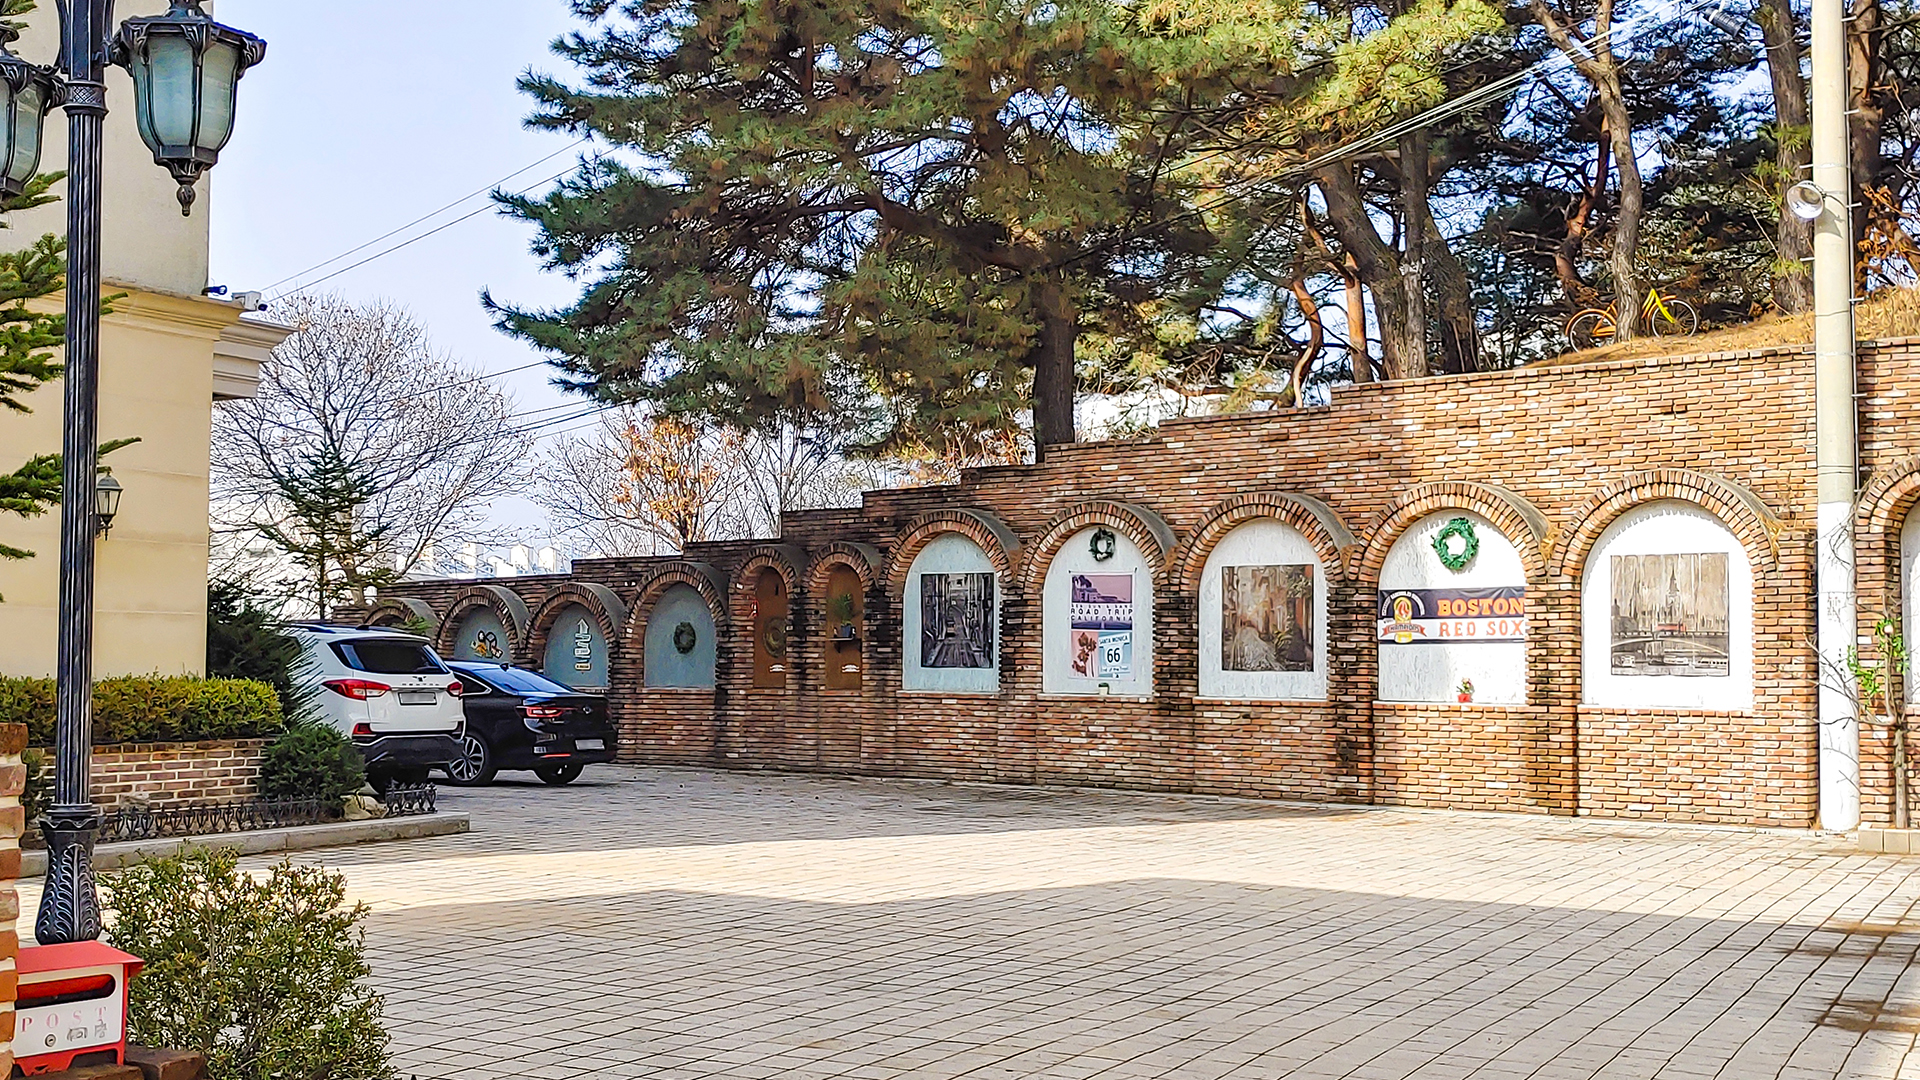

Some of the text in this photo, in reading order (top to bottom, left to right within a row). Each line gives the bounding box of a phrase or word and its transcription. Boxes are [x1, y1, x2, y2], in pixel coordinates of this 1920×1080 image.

[1437, 597, 1525, 616] BOSTON
[1439, 619, 1524, 637] RED SOX
[1107, 647, 1121, 663] 66
[22, 1006, 106, 1032] POST
